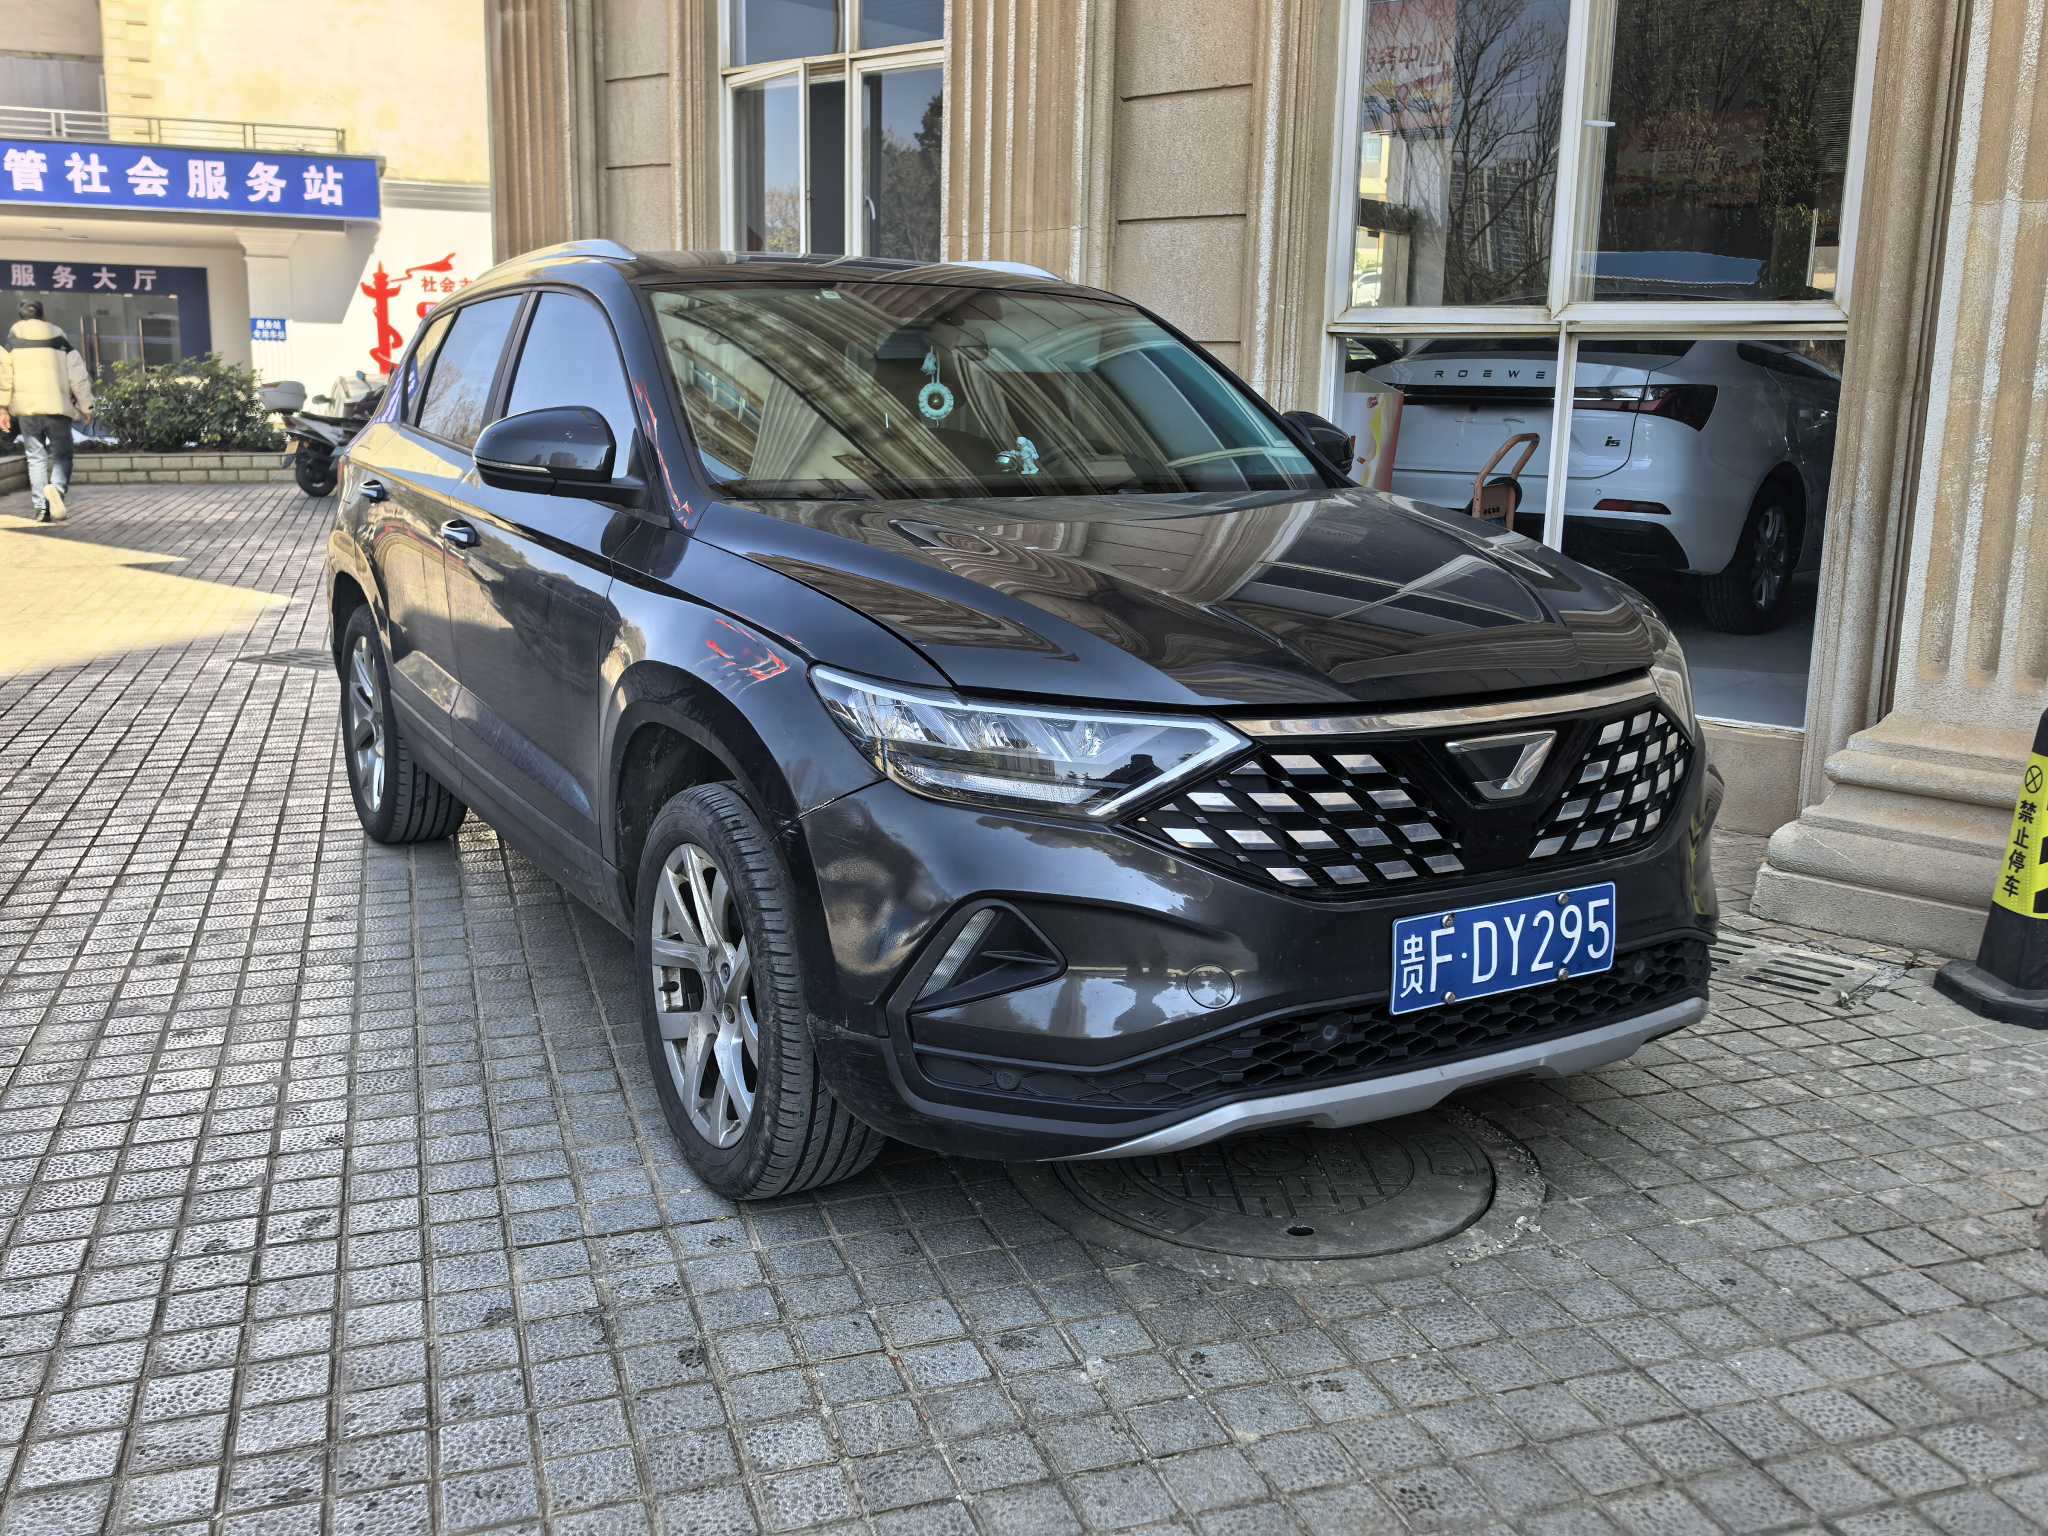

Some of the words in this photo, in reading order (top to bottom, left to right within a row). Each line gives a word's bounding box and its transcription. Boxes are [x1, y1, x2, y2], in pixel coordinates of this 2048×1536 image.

[3, 149, 344, 206] 管社会服务站
[11, 264, 157, 291] 服务大厅
[1434, 369, 1546, 379] ROEWE
[2002, 800, 2037, 898] 禁止停车
